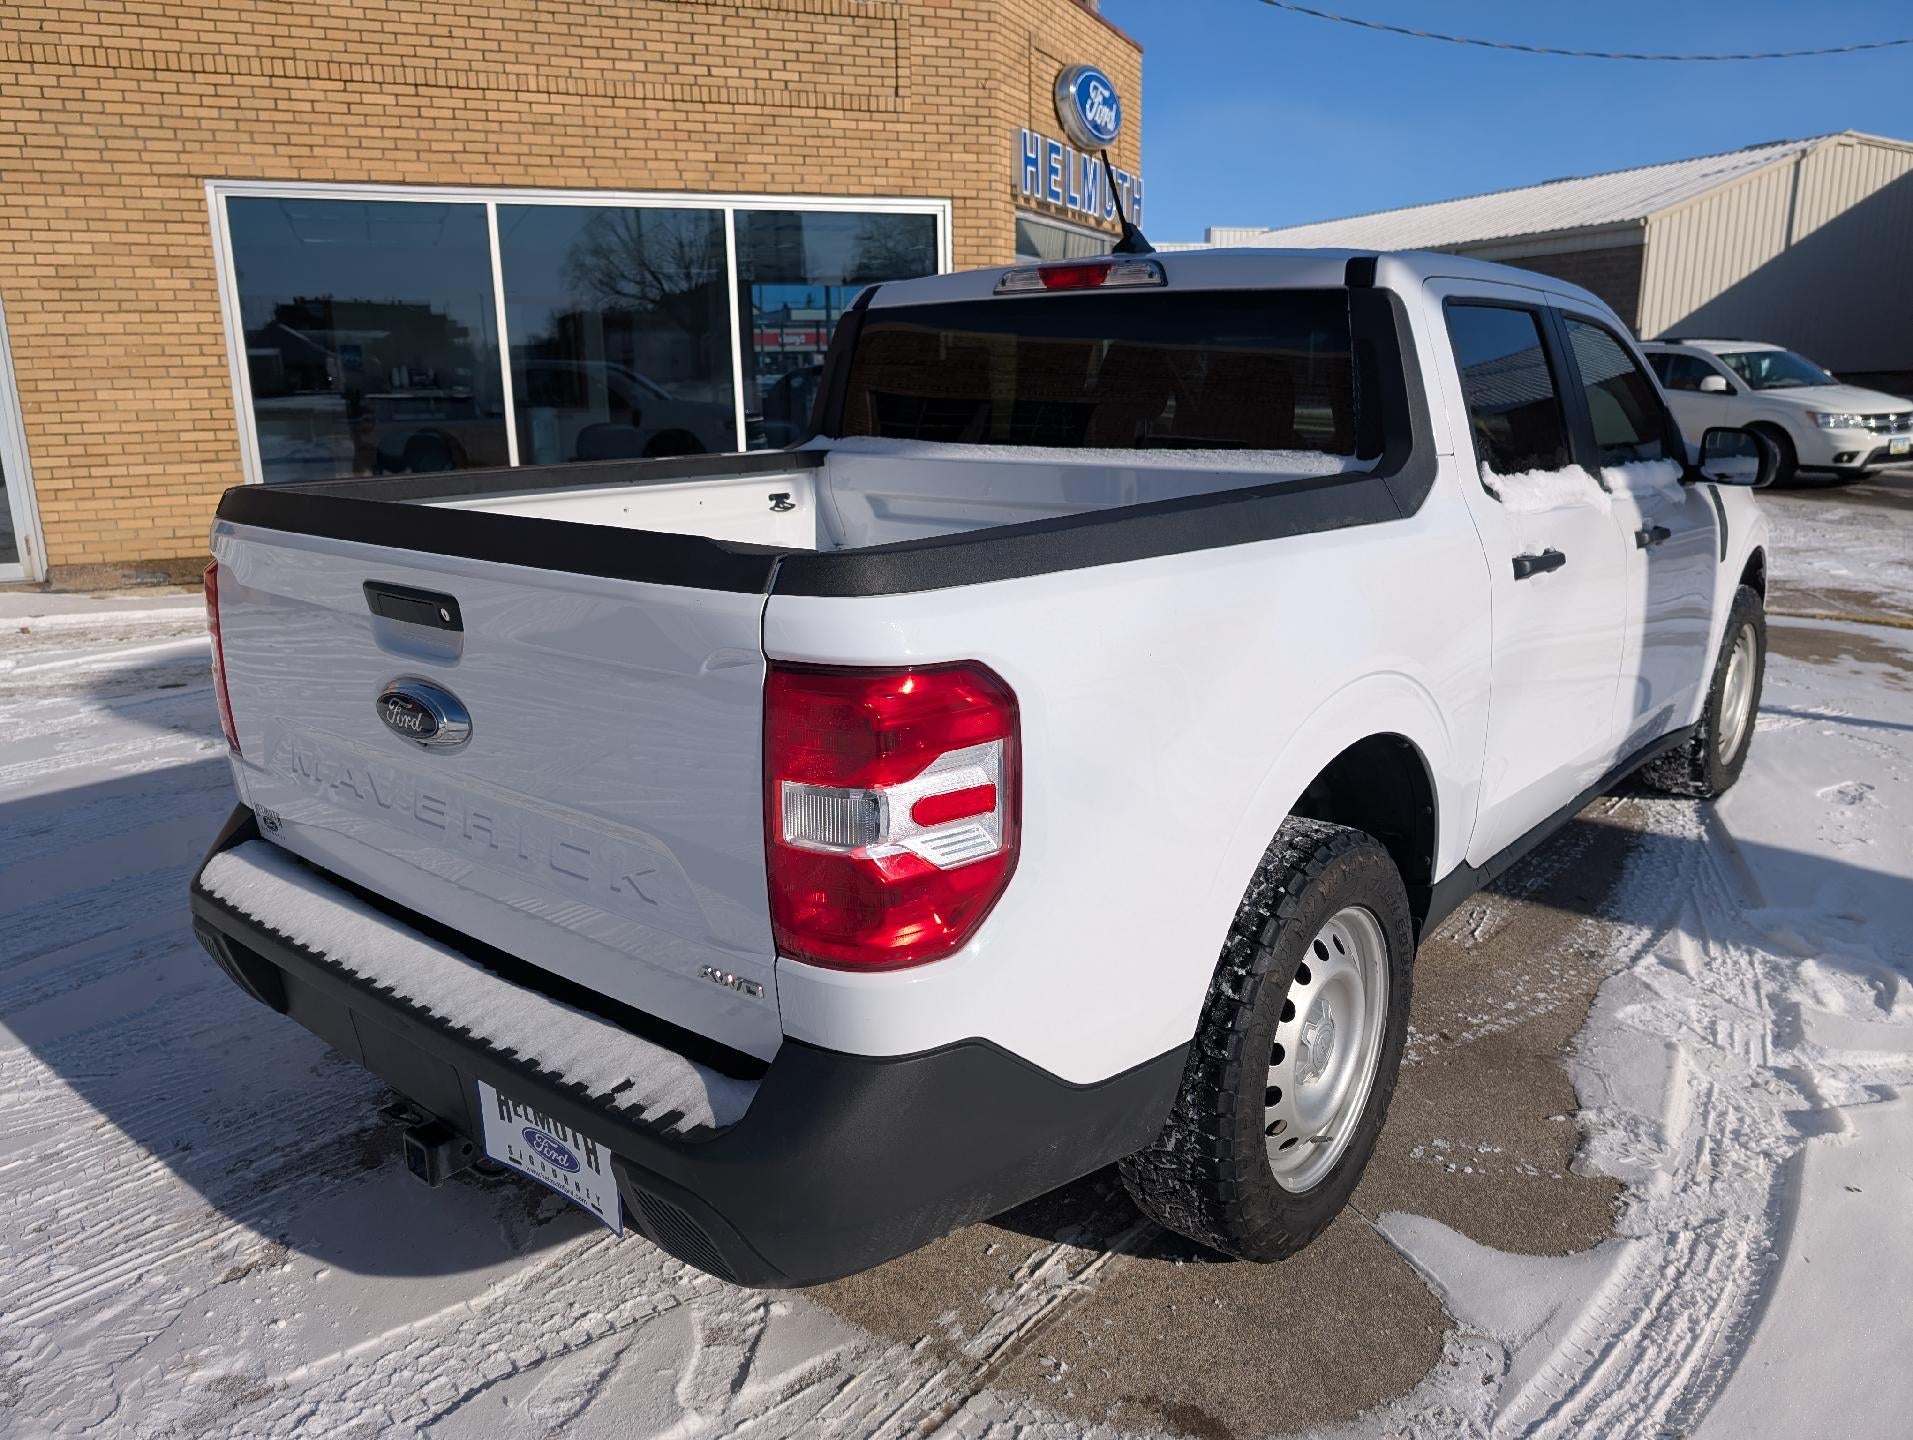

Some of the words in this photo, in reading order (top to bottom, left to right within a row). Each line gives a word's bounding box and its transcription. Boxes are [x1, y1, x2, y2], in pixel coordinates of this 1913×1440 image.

[1085, 80, 1117, 132] Ford
[1021, 127, 1144, 230] HELMUTH
[386, 697, 423, 732] Ford
[290, 740, 658, 906] MAVERICK
[507, 1144, 601, 1207] SIGOURNEY
[533, 1133, 570, 1167] Ford
